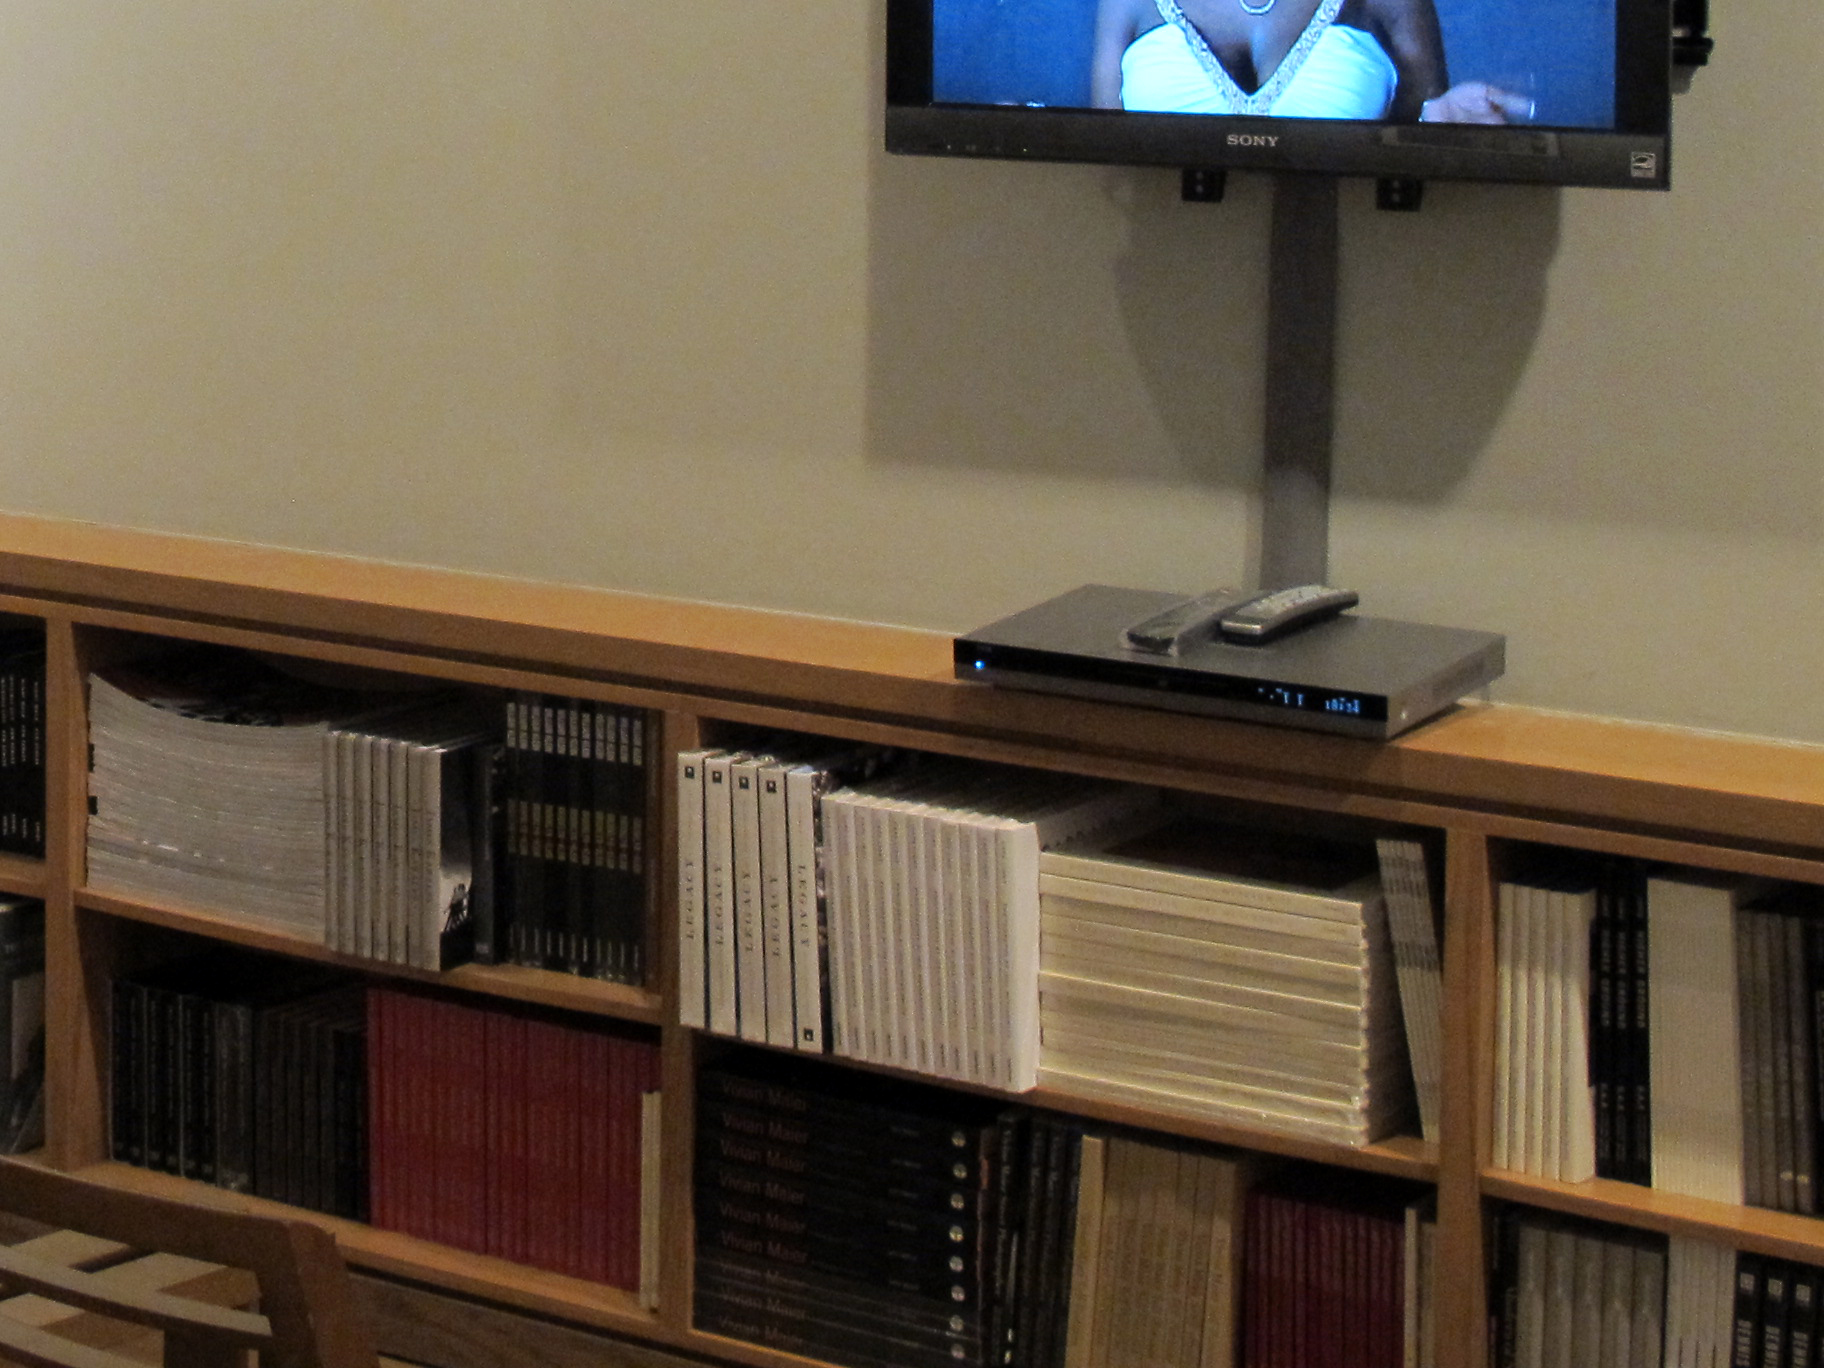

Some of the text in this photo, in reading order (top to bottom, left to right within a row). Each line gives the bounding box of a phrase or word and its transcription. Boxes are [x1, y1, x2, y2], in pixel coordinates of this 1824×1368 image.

[1227, 134, 1279, 147] SONY
[721, 1138, 804, 1172] Vivian Maier
[720, 1169, 804, 1205] Vivian Maier
[720, 1201, 805, 1232] Vivian Maier
[722, 1231, 808, 1263] Vivian Maier
